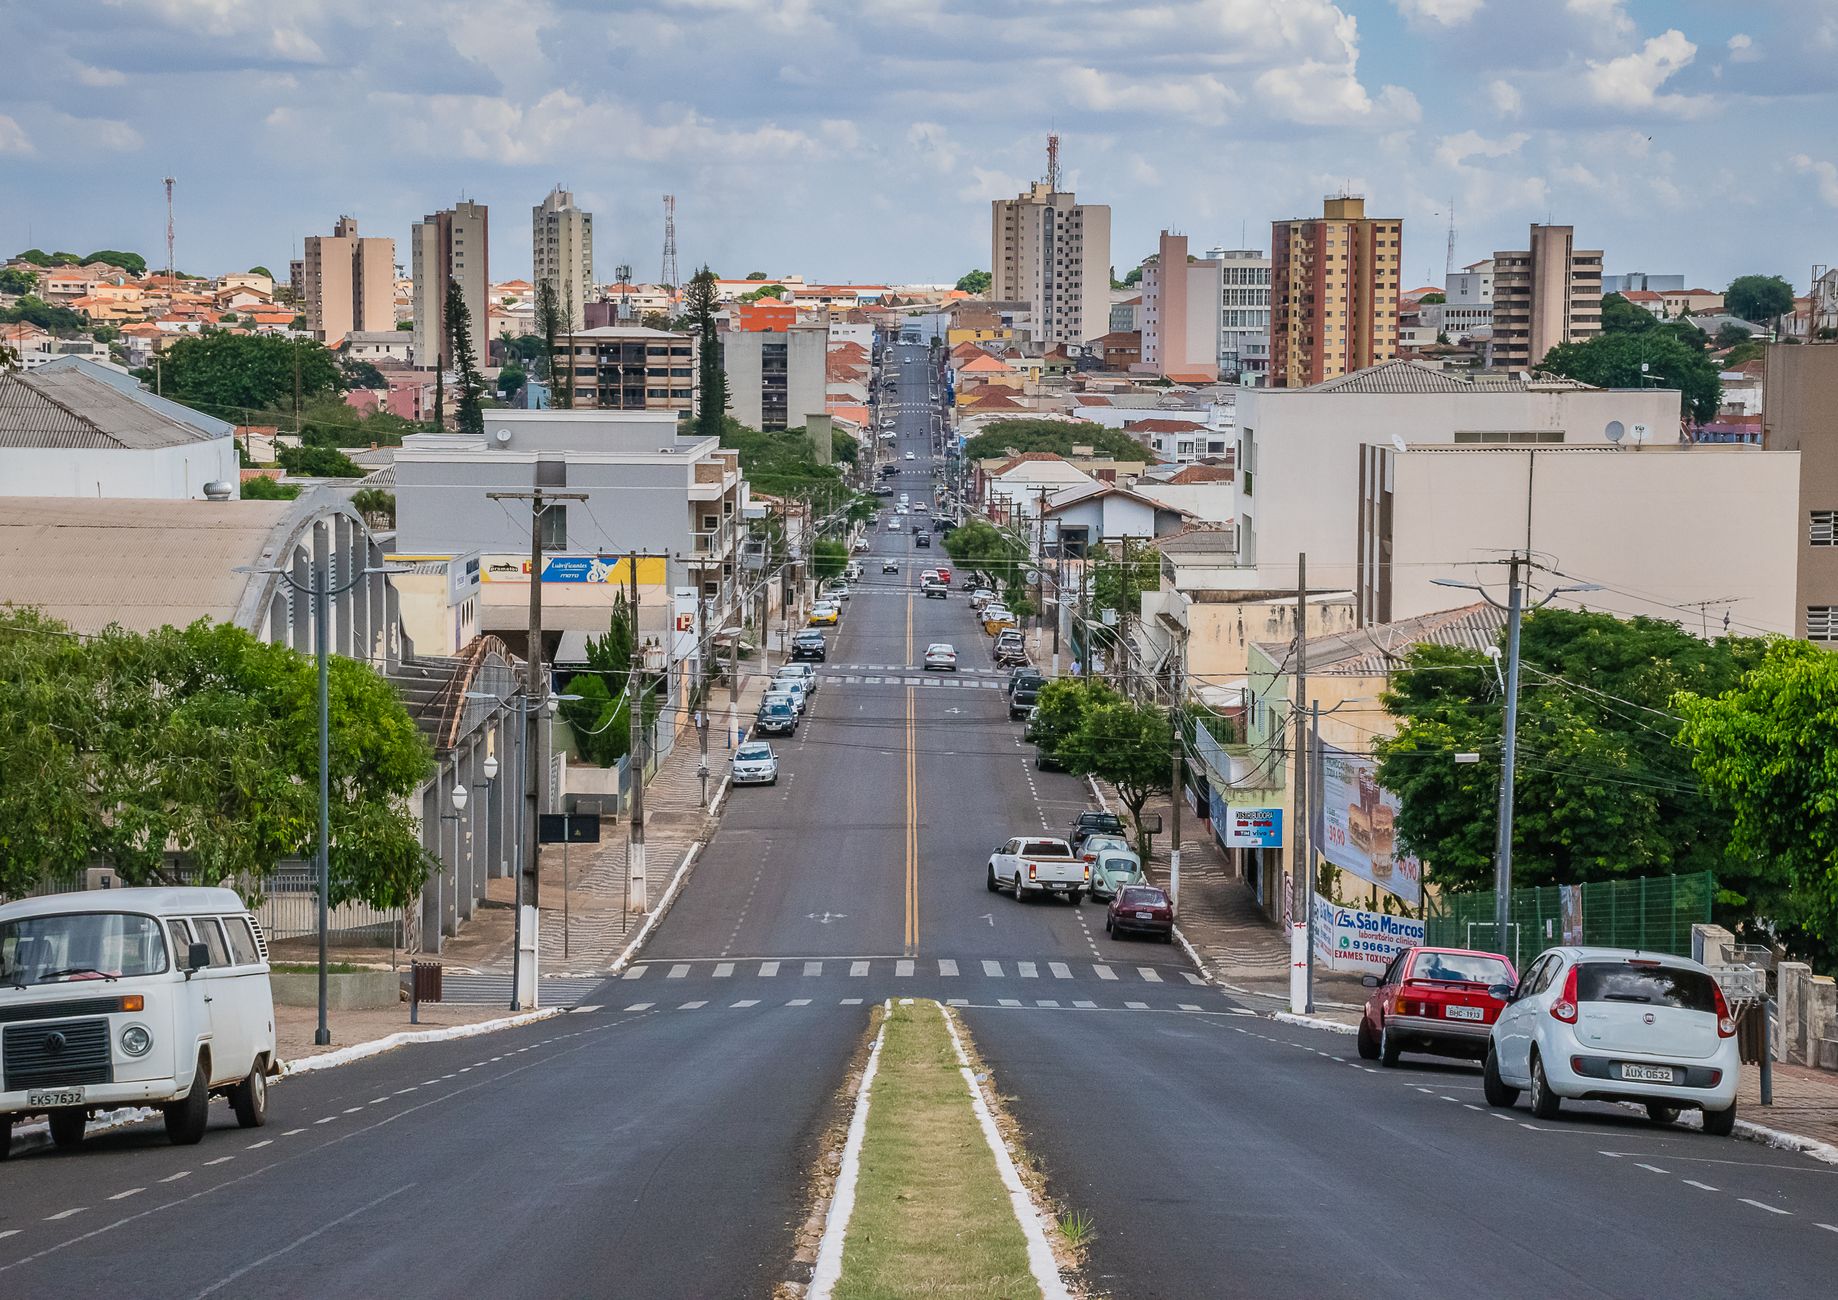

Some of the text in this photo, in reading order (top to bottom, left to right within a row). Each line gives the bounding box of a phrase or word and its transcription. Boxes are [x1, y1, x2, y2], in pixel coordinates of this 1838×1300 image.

[1328, 825, 1345, 847] 39,90
[1356, 911, 1378, 932] São
[1380, 915, 1424, 938] Marcos
[1358, 930, 1394, 943] laboratório
[1334, 950, 1364, 961] EXAMES
[1625, 1066, 1671, 1080] AUX-0632
[30, 1092, 82, 1107] EKS-7632
